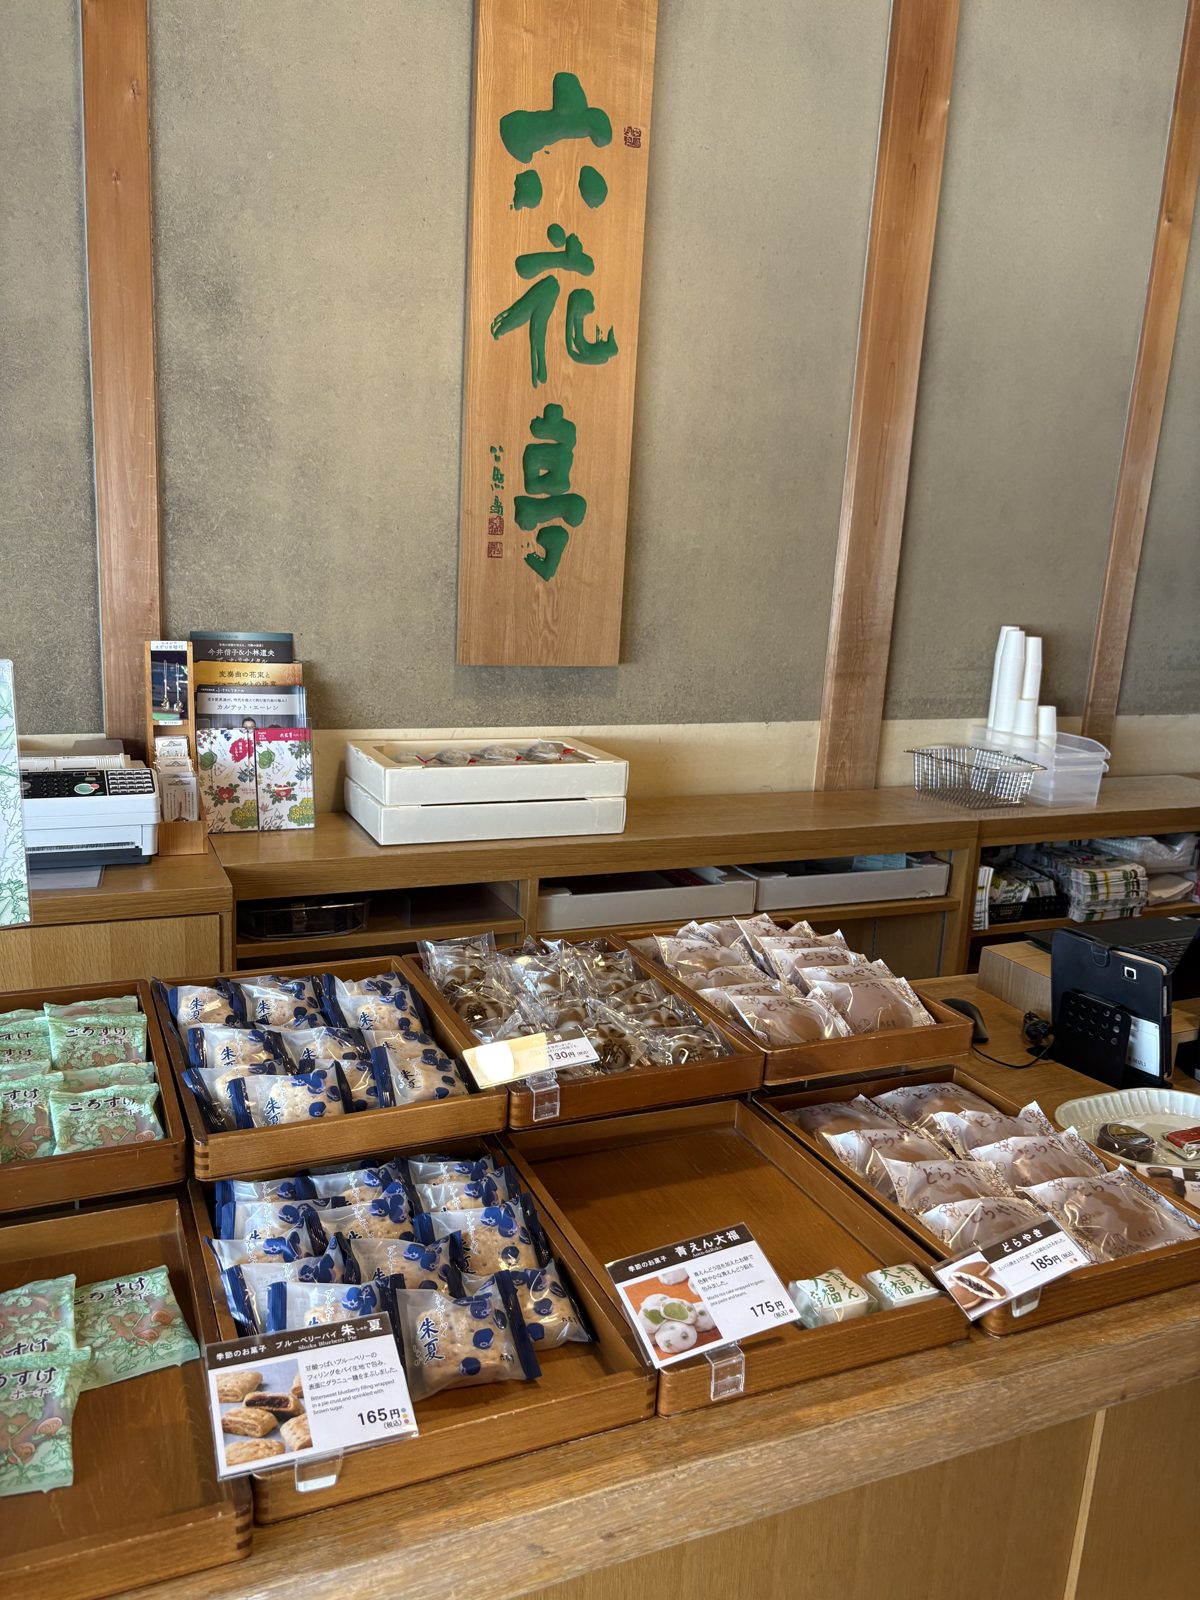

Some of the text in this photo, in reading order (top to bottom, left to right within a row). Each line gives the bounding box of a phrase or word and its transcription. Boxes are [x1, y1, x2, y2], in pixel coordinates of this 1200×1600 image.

[490, 72, 619, 582] 六花亭
[627, 1229, 741, 1273] 季節のお菓子 青えん大福
[1001, 1228, 1044, 1253] どらやき
[1030, 1254, 1062, 1272] 185円
[879, 1268, 914, 1296] 大福
[896, 1266, 931, 1291] 青えん
[750, 1300, 785, 1317] 175円
[215, 1344, 268, 1361] 季節のお菓子
[275, 1331, 337, 1350] ブルーベリーパイ
[419, 1317, 445, 1365] 朱夏
[305, 1351, 378, 1372] 甘酸っぱいブルーベリーの
[374, 1379, 395, 1388] wrapped
[357, 1407, 401, 1426] 165円
[383, 1418, 402, 1429] (税込)
